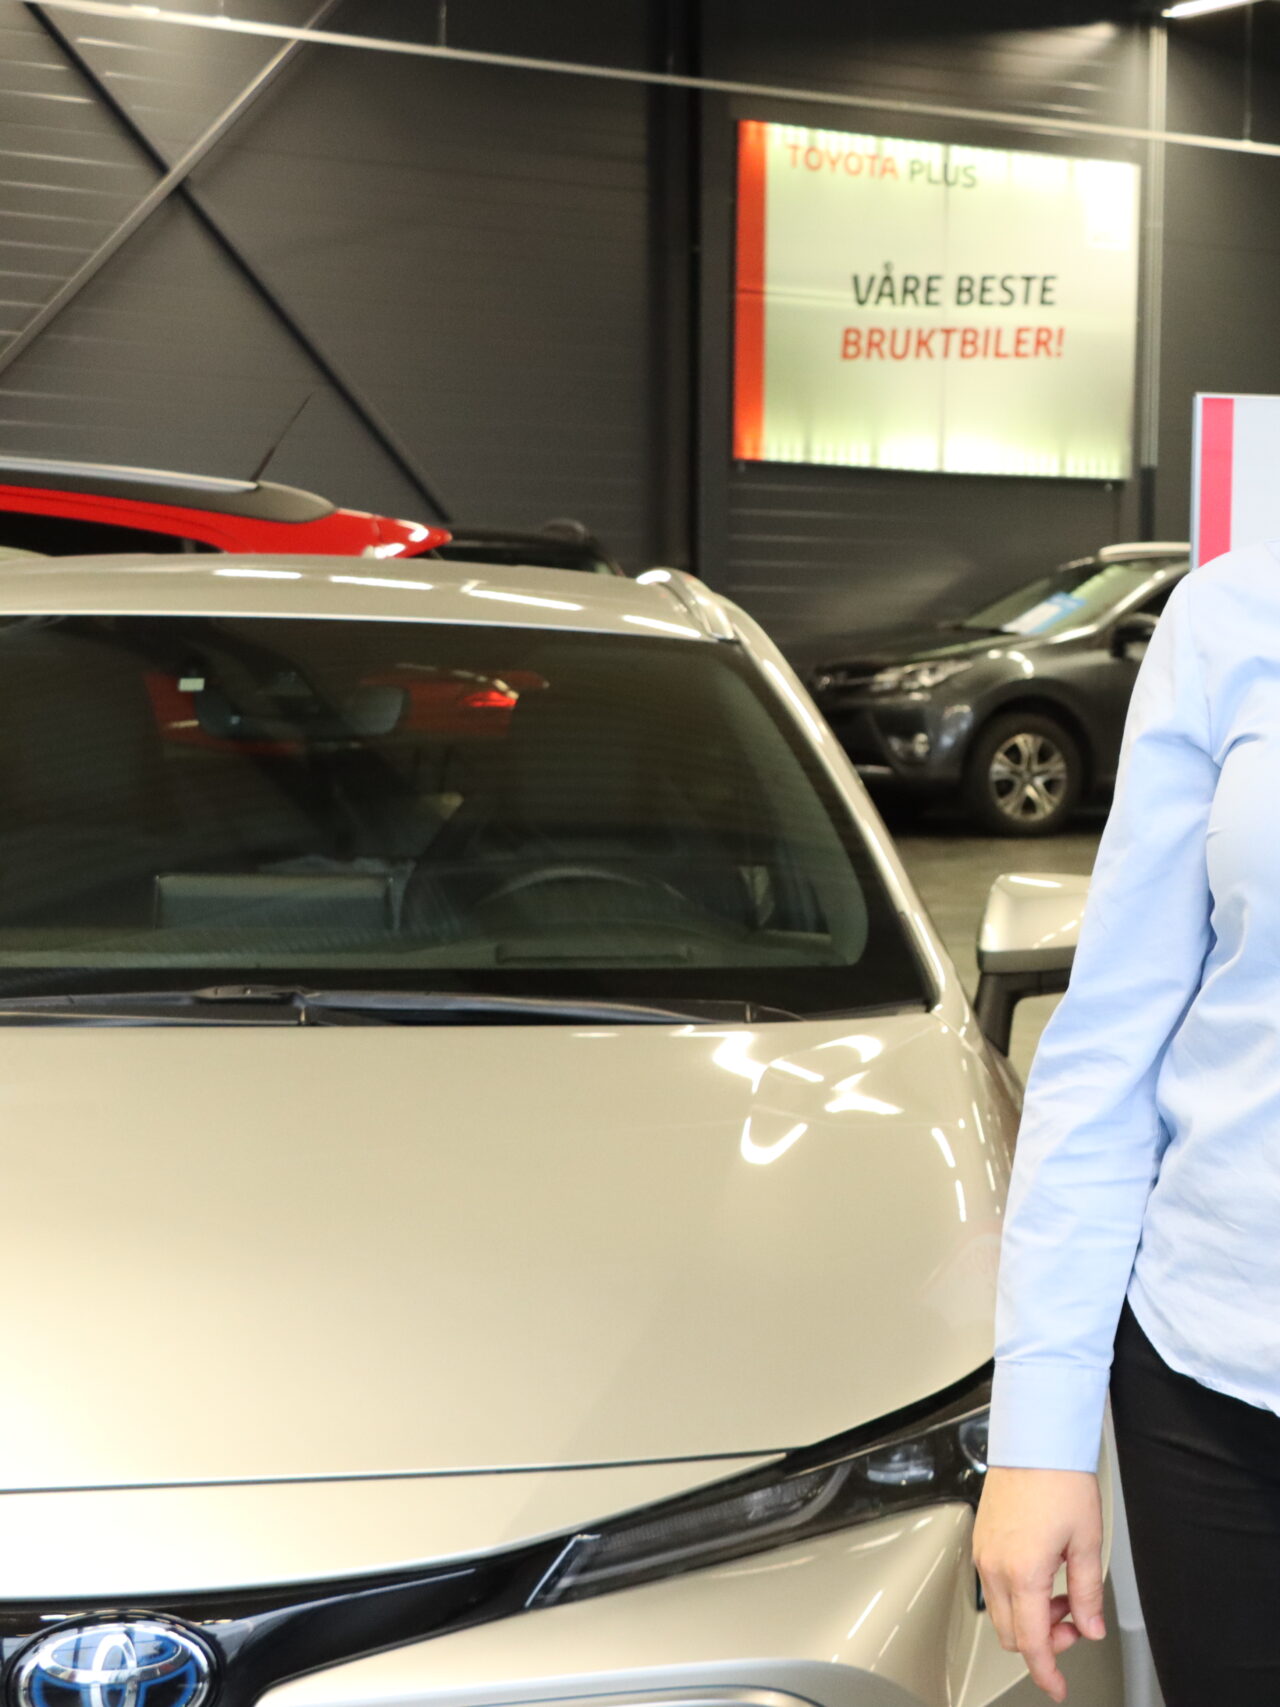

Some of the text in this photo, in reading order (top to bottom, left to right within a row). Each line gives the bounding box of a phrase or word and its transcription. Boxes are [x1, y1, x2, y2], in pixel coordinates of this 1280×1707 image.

[786, 144, 978, 188] TOYOTA PLUS
[852, 261, 1058, 306] VÅRE BESTE
[840, 326, 1065, 361] BRUKTBILER!
